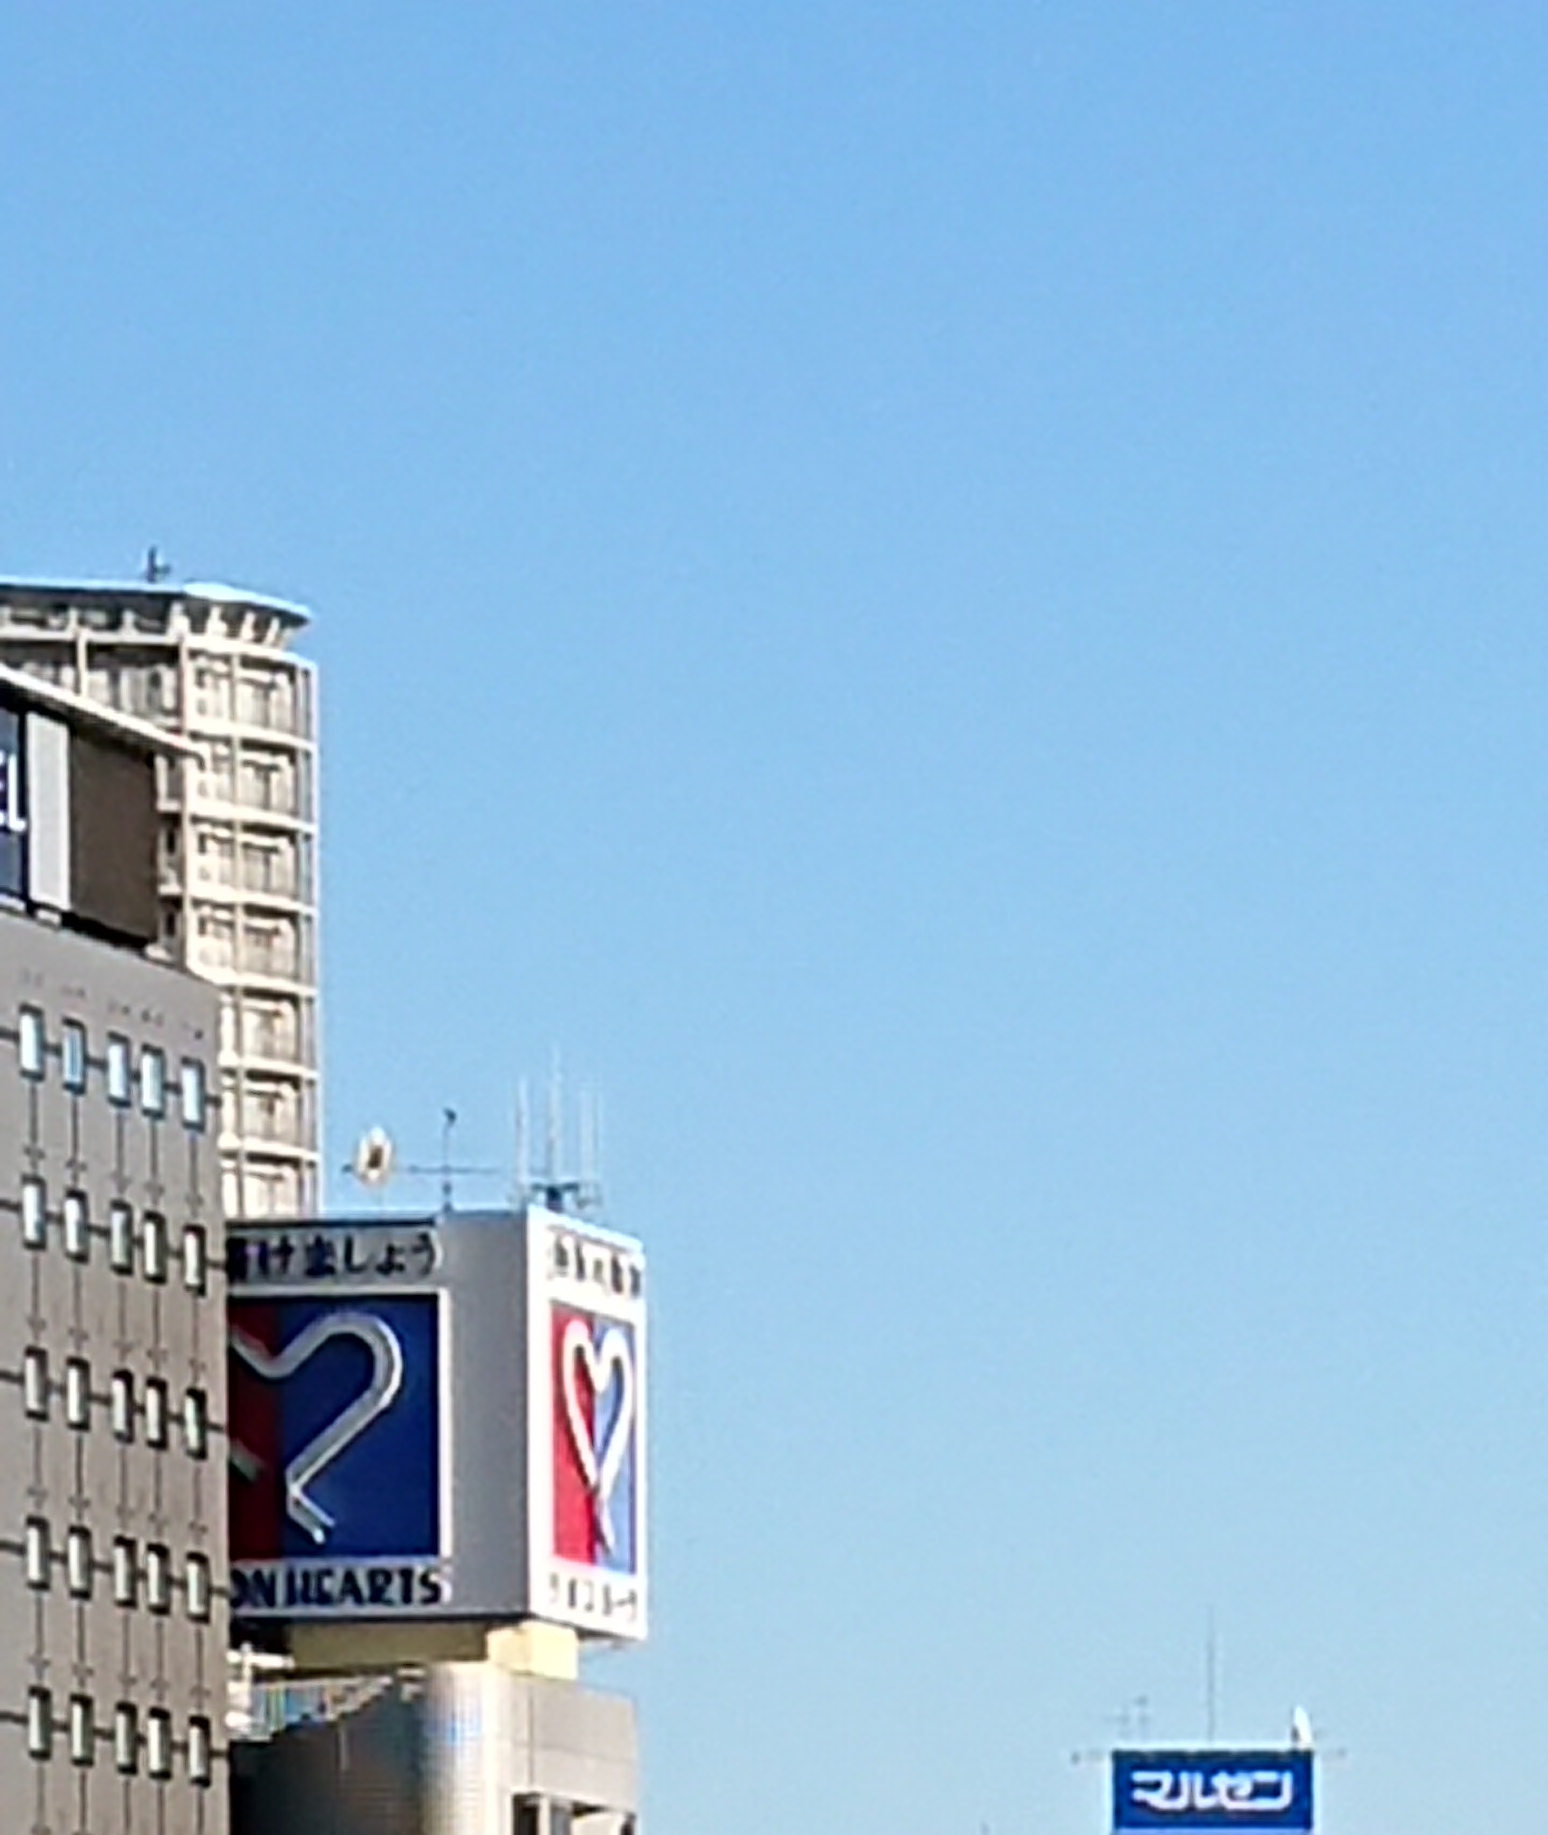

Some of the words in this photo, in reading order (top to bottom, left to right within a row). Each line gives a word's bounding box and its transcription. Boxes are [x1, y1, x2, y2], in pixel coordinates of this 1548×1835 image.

[286, 1567, 441, 1606] HEARTS
[1131, 1770, 1294, 1810] マルゼン
